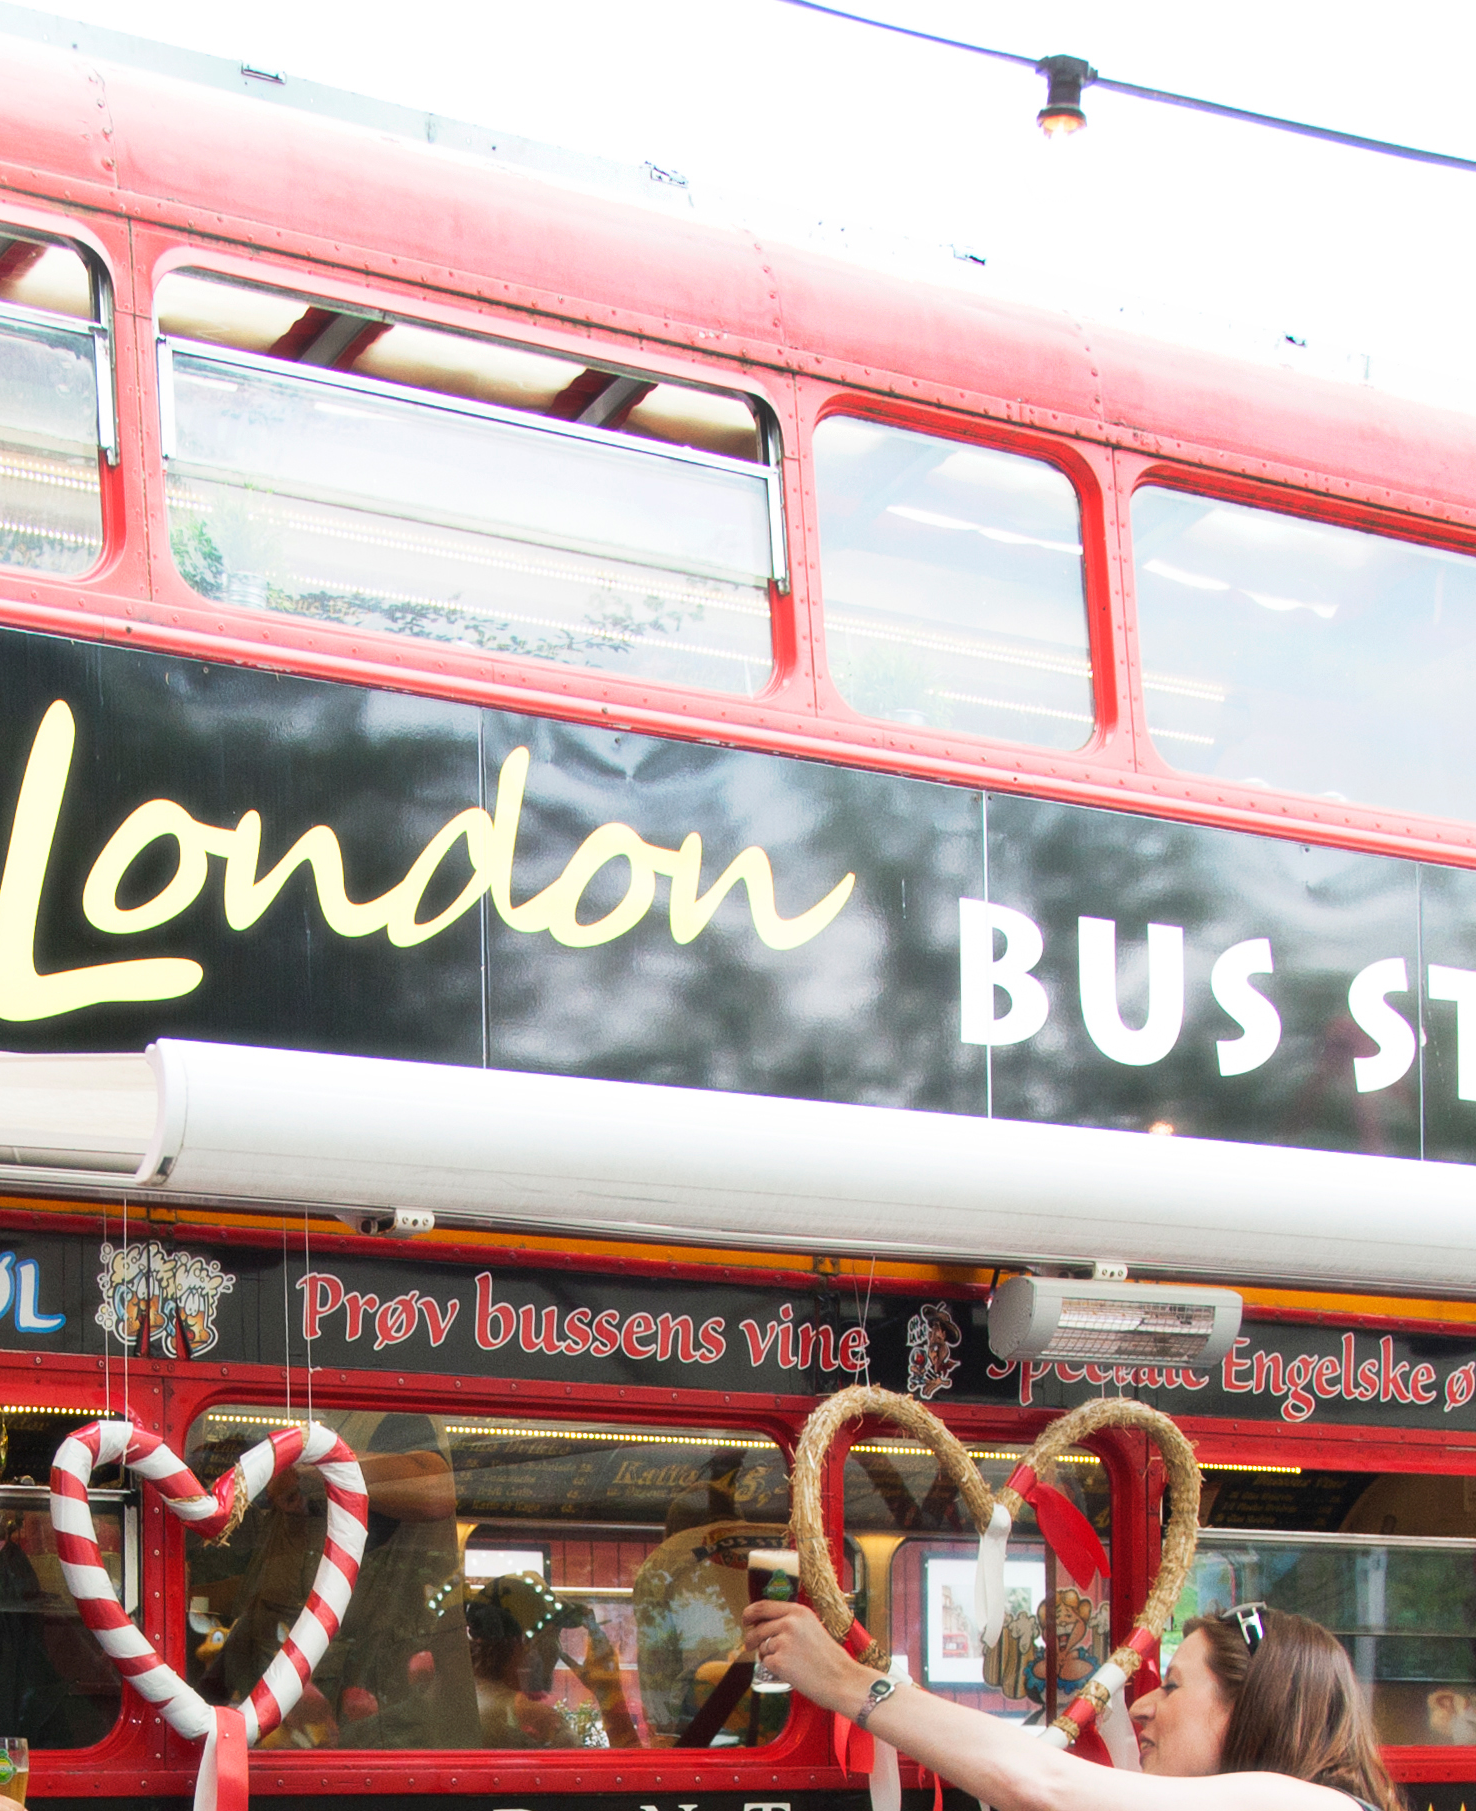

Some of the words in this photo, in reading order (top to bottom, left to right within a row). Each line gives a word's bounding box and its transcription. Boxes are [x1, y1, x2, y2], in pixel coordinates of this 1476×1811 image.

[959, 896, 1282, 1077] BUS
[296, 1272, 461, 1352] Prøv
[475, 1271, 726, 1366] bussens
[739, 1302, 870, 1374] vine
[1222, 1332, 1437, 1422] Engelske
